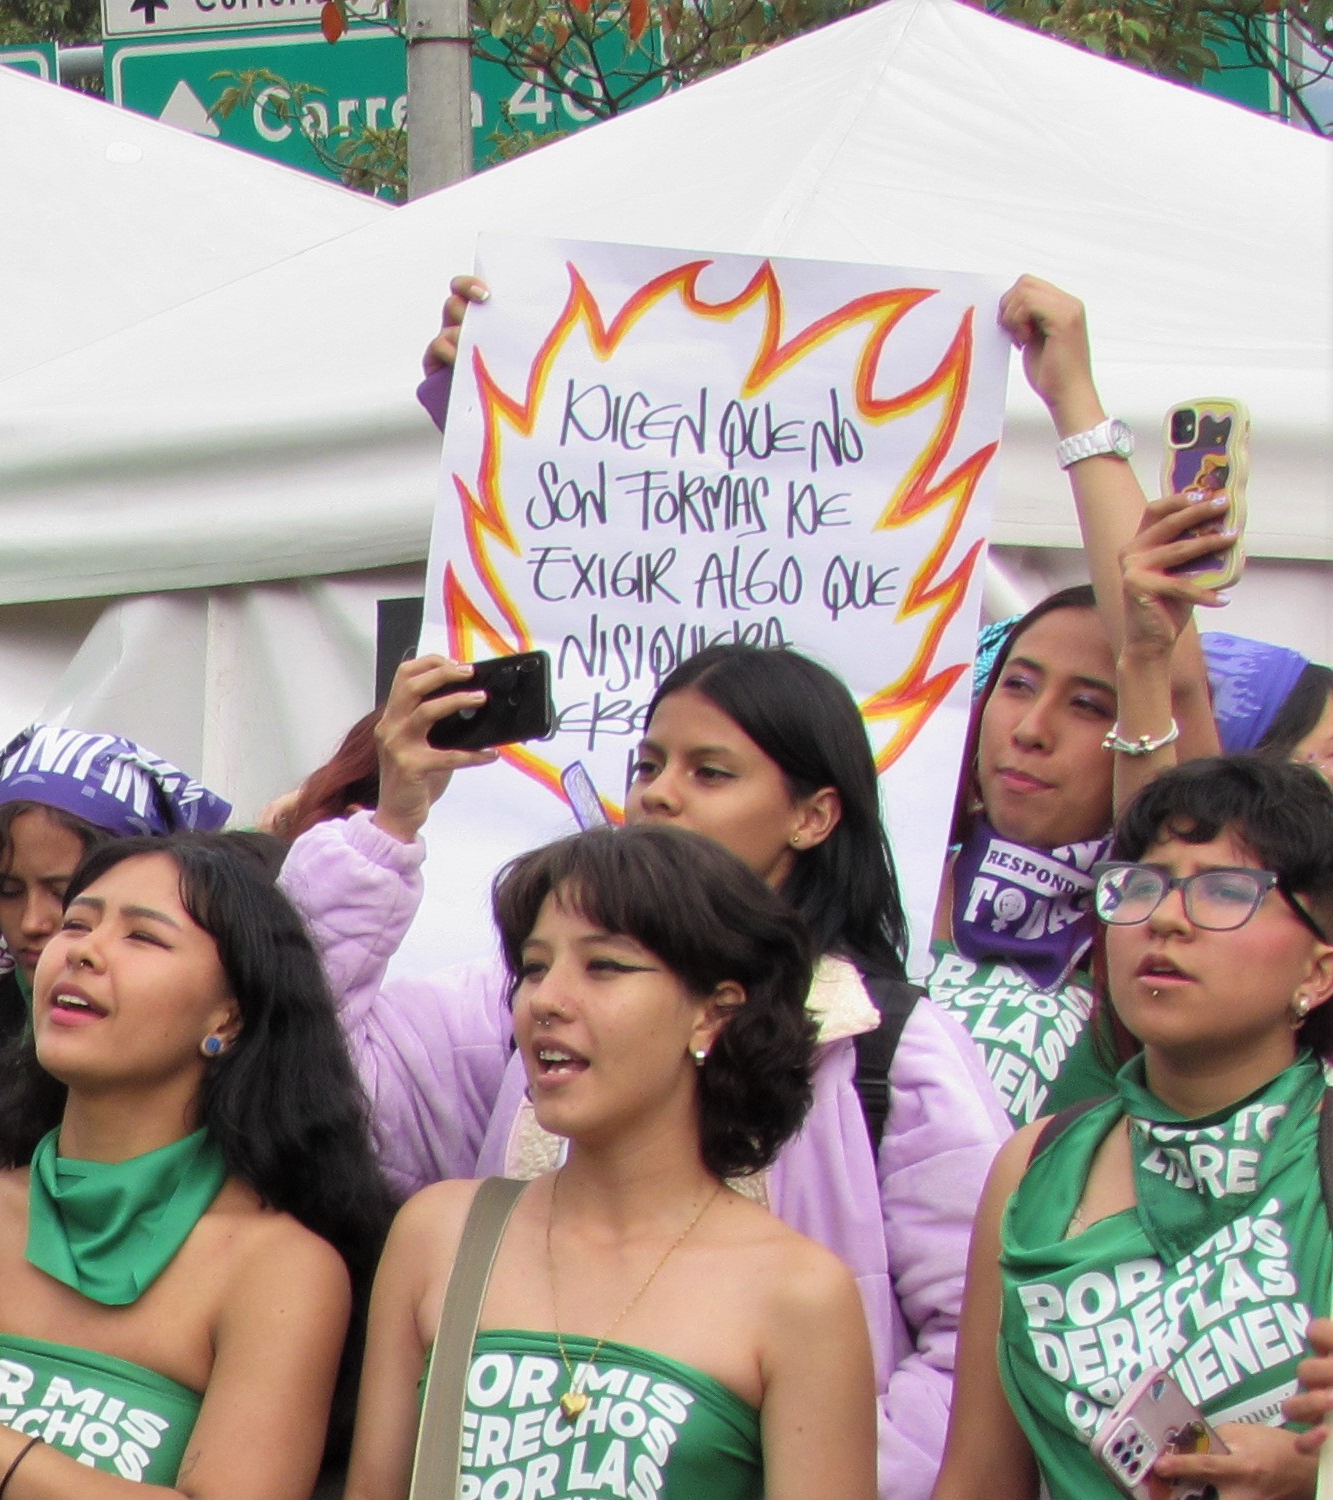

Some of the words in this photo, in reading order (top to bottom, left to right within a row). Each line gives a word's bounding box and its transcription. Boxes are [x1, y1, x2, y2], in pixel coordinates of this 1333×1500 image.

[560, 379, 708, 458] DICEN
[526, 461, 607, 530] SON
[616, 470, 770, 538] FORMAS
[786, 478, 853, 539] DE
[526, 546, 682, 605] EXIGIR
[694, 547, 803, 611] ALGO
[821, 554, 901, 622] QUE
[39, 1376, 170, 1450] MIS
[569, 1362, 696, 1425] MIS
